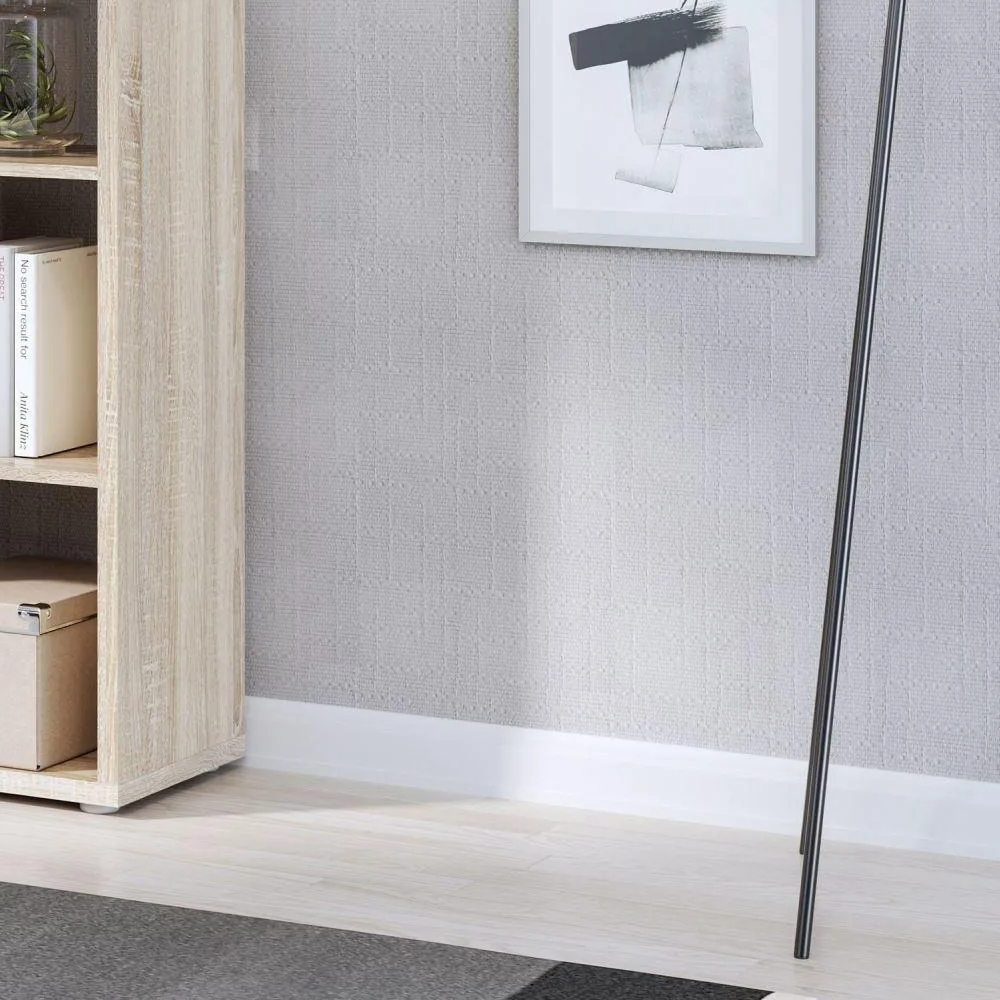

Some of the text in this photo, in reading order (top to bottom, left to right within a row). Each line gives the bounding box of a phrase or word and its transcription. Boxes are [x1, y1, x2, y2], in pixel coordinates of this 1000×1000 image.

[20, 260, 29, 360] No search result for
[19, 392, 29, 420] Anita
